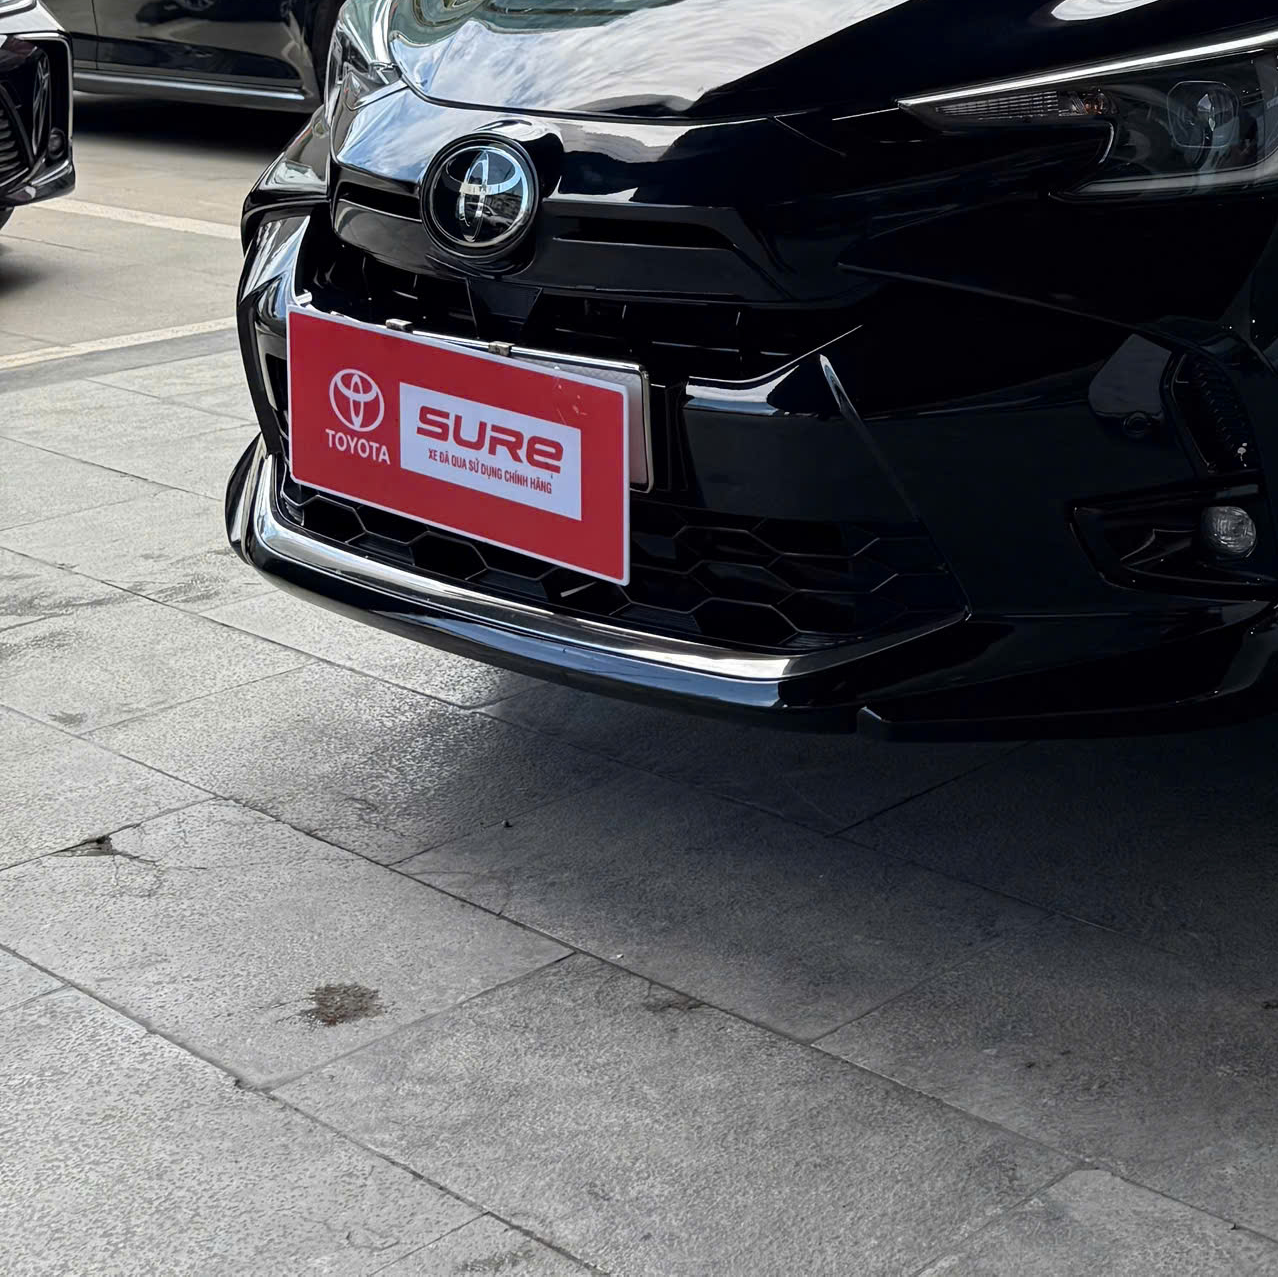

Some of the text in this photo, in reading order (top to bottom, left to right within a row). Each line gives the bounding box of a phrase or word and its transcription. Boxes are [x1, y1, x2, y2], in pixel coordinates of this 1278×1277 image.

[325, 428, 391, 465] TOYOTA
[428, 448, 552, 494] XE ĐÃ QUA SỬ DỤNG CHÍNH HÃNG
